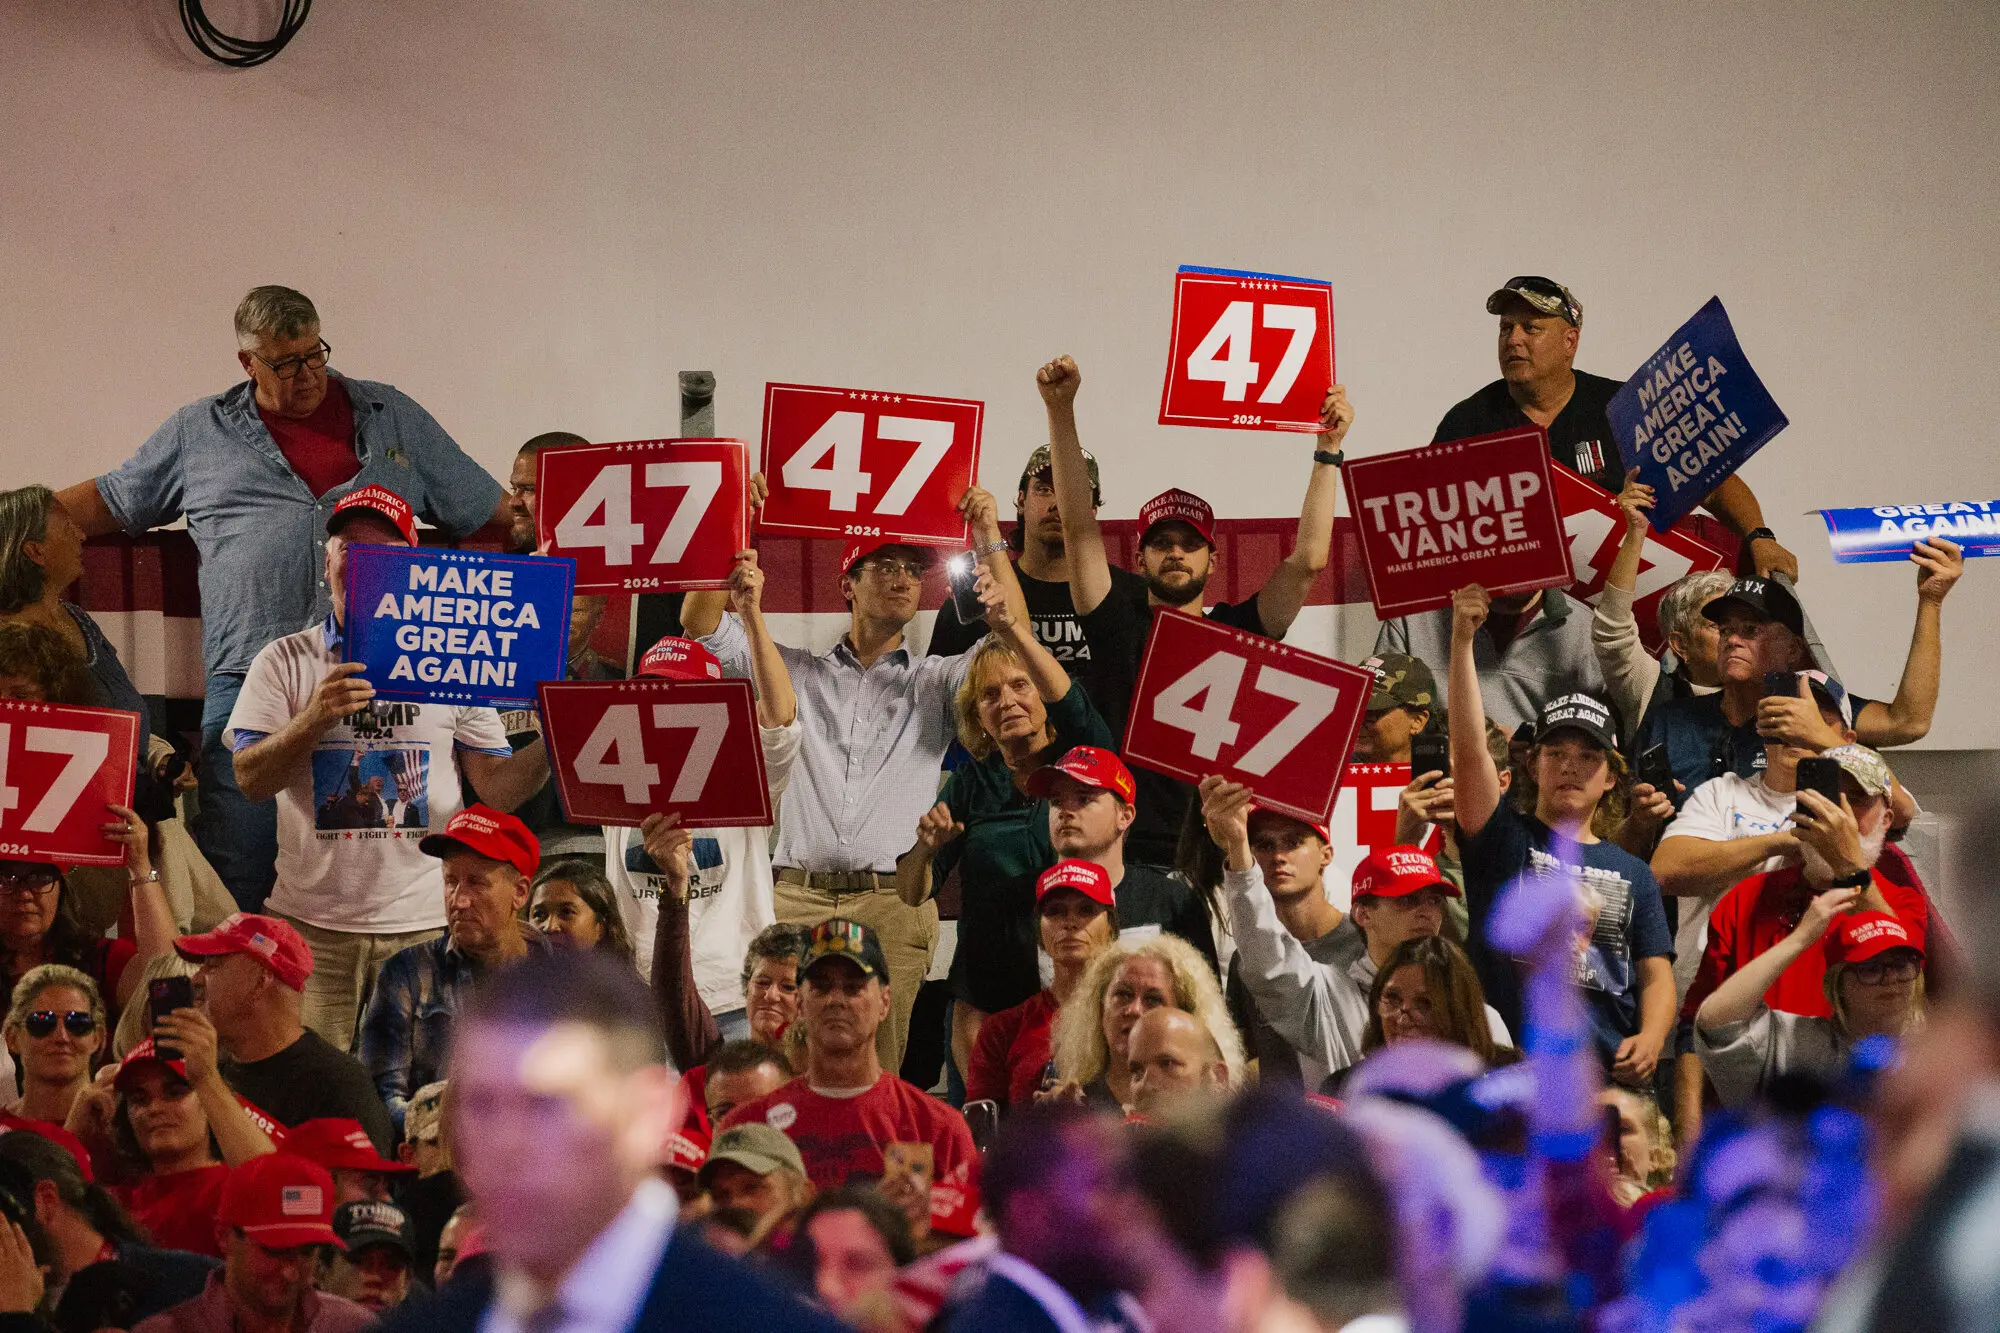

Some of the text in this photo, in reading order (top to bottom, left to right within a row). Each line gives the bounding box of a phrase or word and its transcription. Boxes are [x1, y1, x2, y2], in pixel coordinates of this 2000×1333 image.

[1187, 301, 1316, 404] 47
[1637, 341, 1698, 412] MAKE
[1634, 355, 1728, 453] AMERICA
[1232, 414, 1261, 425] 2024
[1652, 387, 1726, 464] GREAT
[781, 410, 955, 516] 47
[1665, 411, 1748, 493] AGAIN!
[364, 488, 407, 513] AMERICA
[371, 501, 400, 521] AGAIN
[554, 461, 722, 566] 47
[1143, 494, 1210, 515] MAKE AMERICA
[1363, 471, 1541, 532] TRUMP
[1872, 501, 1993, 518] GREAT
[1148, 506, 1204, 525] GREAT AGAIN
[844, 524, 881, 537] 2024
[1388, 510, 1528, 560] VANCE
[1387, 539, 1542, 574] MAKE AMERICA GREAT AGAIN!
[409, 564, 513, 597] MAKE
[623, 577, 660, 588] 2024
[374, 593, 540, 629] AMERICA
[395, 625, 518, 657] GREAT
[388, 655, 517, 687] AGAIN!
[644, 652, 688, 667] TRUMP
[1153, 650, 1340, 778] 47
[1546, 707, 1605, 728] GREAT AGAIN
[1569, 693, 1610, 716] AMERICA
[353, 727, 394, 740] 2024
[572, 702, 730, 804] 47
[359, 831, 388, 839] FIGHT
[1062, 865, 1099, 881] AMERICA
[1386, 852, 1433, 867] TRUMP
[1390, 865, 1429, 876] VANCE
